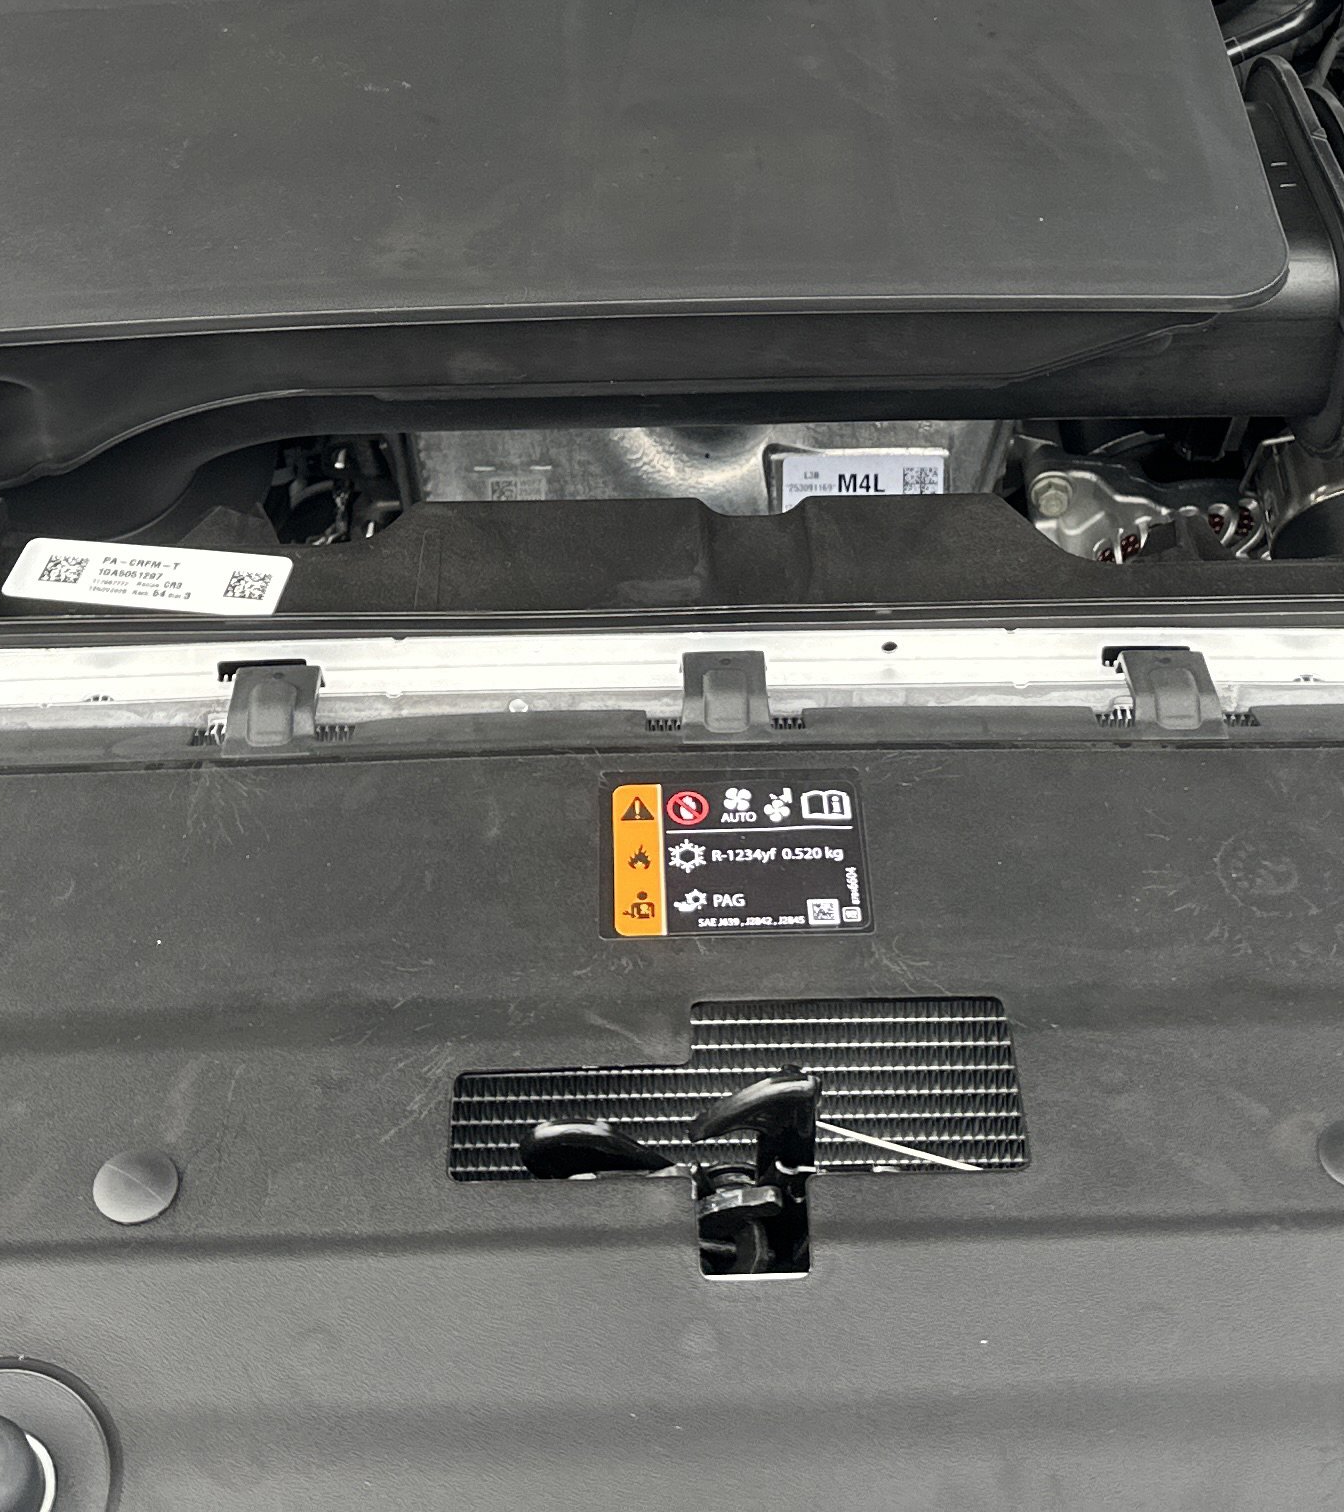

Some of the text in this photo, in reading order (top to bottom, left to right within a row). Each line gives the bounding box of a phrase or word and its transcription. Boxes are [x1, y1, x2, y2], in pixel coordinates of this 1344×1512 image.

[837, 473, 886, 493] M4L
[720, 811, 758, 823] AUTO
[711, 846, 845, 863] R-1234yf 0.520 kg
[712, 893, 746, 908] PAG
[698, 917, 717, 928] SAE
